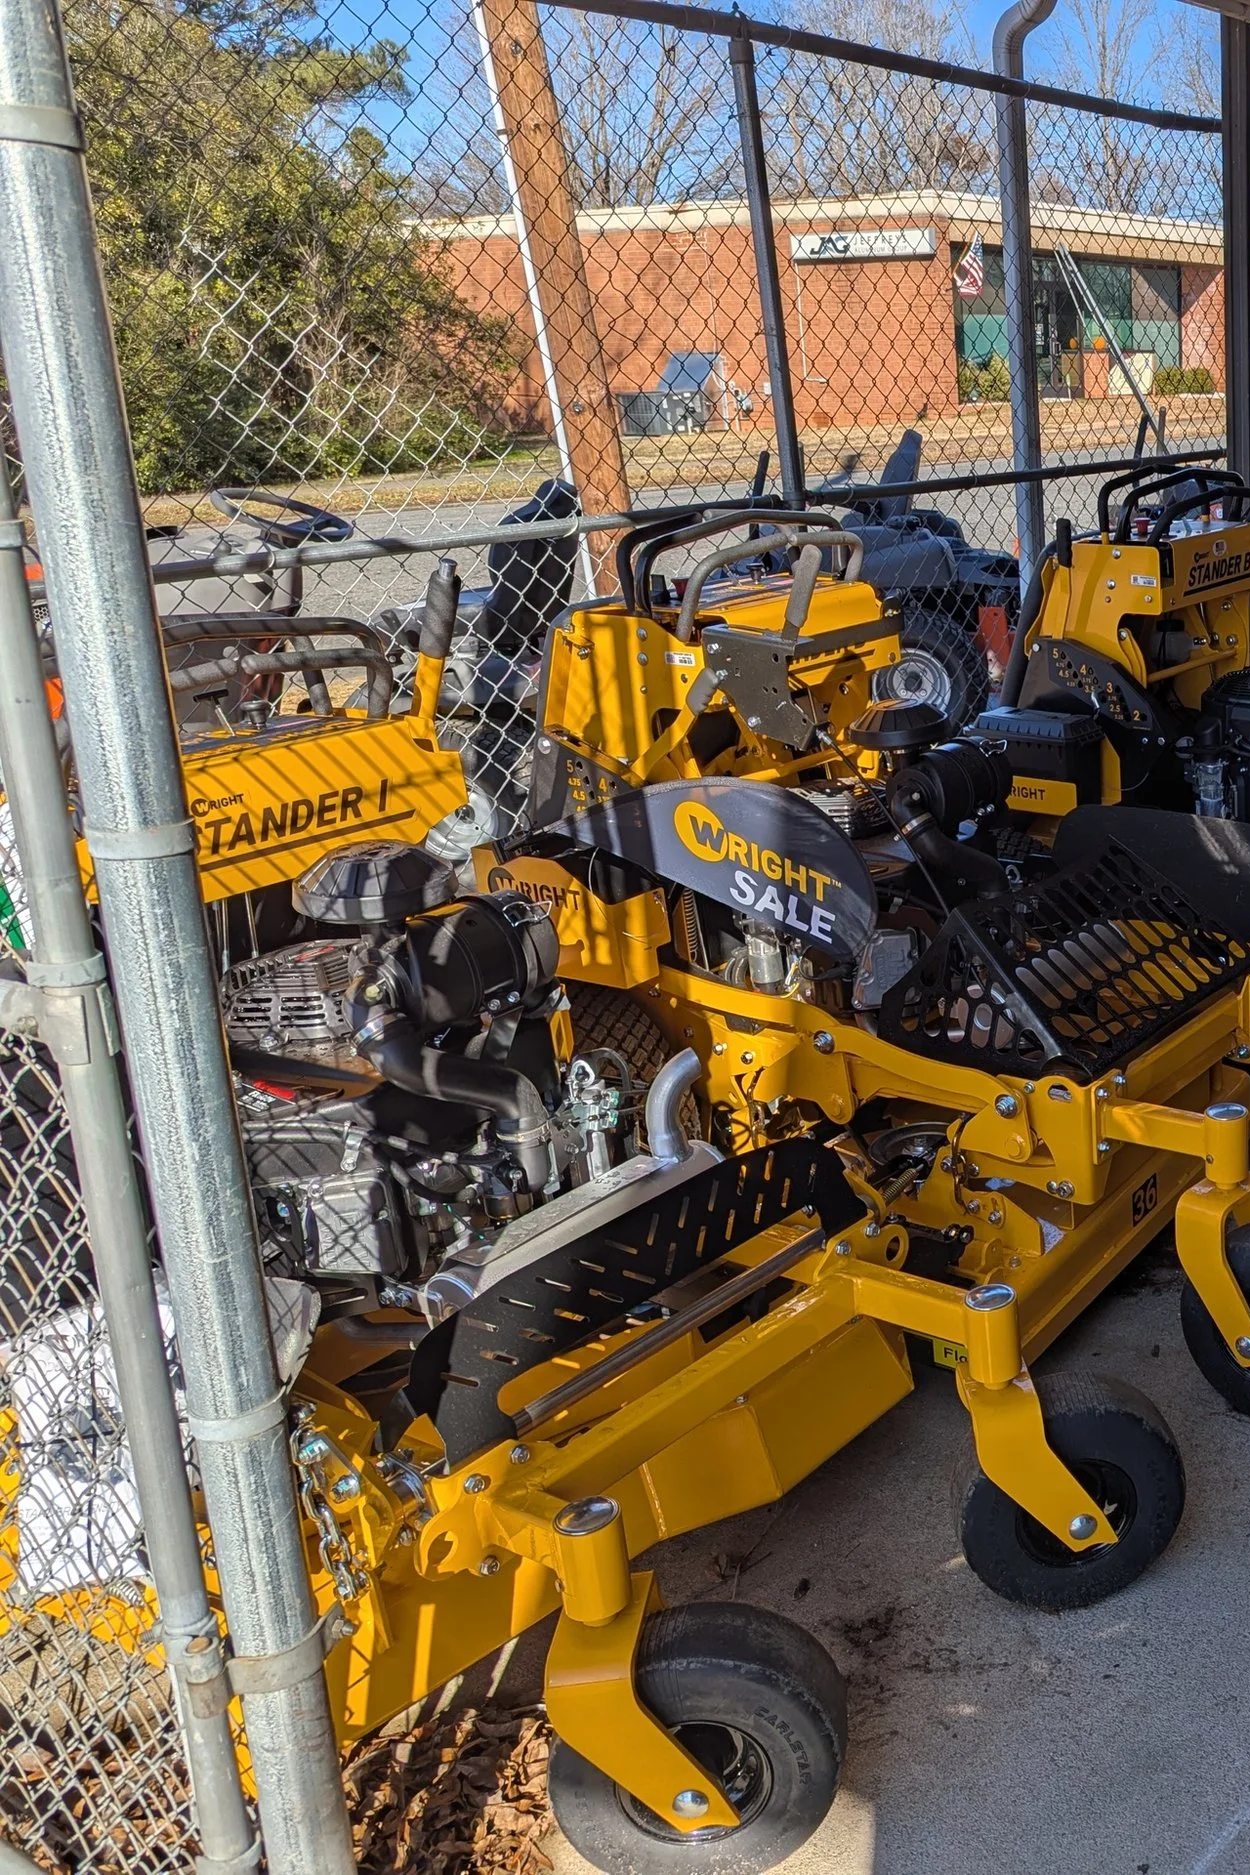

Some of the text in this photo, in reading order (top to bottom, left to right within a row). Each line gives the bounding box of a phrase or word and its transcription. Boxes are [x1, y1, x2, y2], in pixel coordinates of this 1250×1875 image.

[853, 235, 907, 246] JEFFREYS
[1188, 554, 1242, 587] STANDER
[1052, 648, 1059, 659] 5
[1080, 664, 1087, 675] 4
[1106, 682, 1113, 693] 3
[1133, 710, 1141, 721] 2
[566, 760, 575, 774] 5
[598, 777, 608, 793] 4
[572, 789, 587, 801] 4.5
[1010, 785, 1046, 801] RIGHT
[191, 793, 245, 818] WRIGHT
[729, 870, 836, 944] SALE
[1133, 1177, 1156, 1222] 36
[753, 1705, 812, 1785] CARLSTAR
